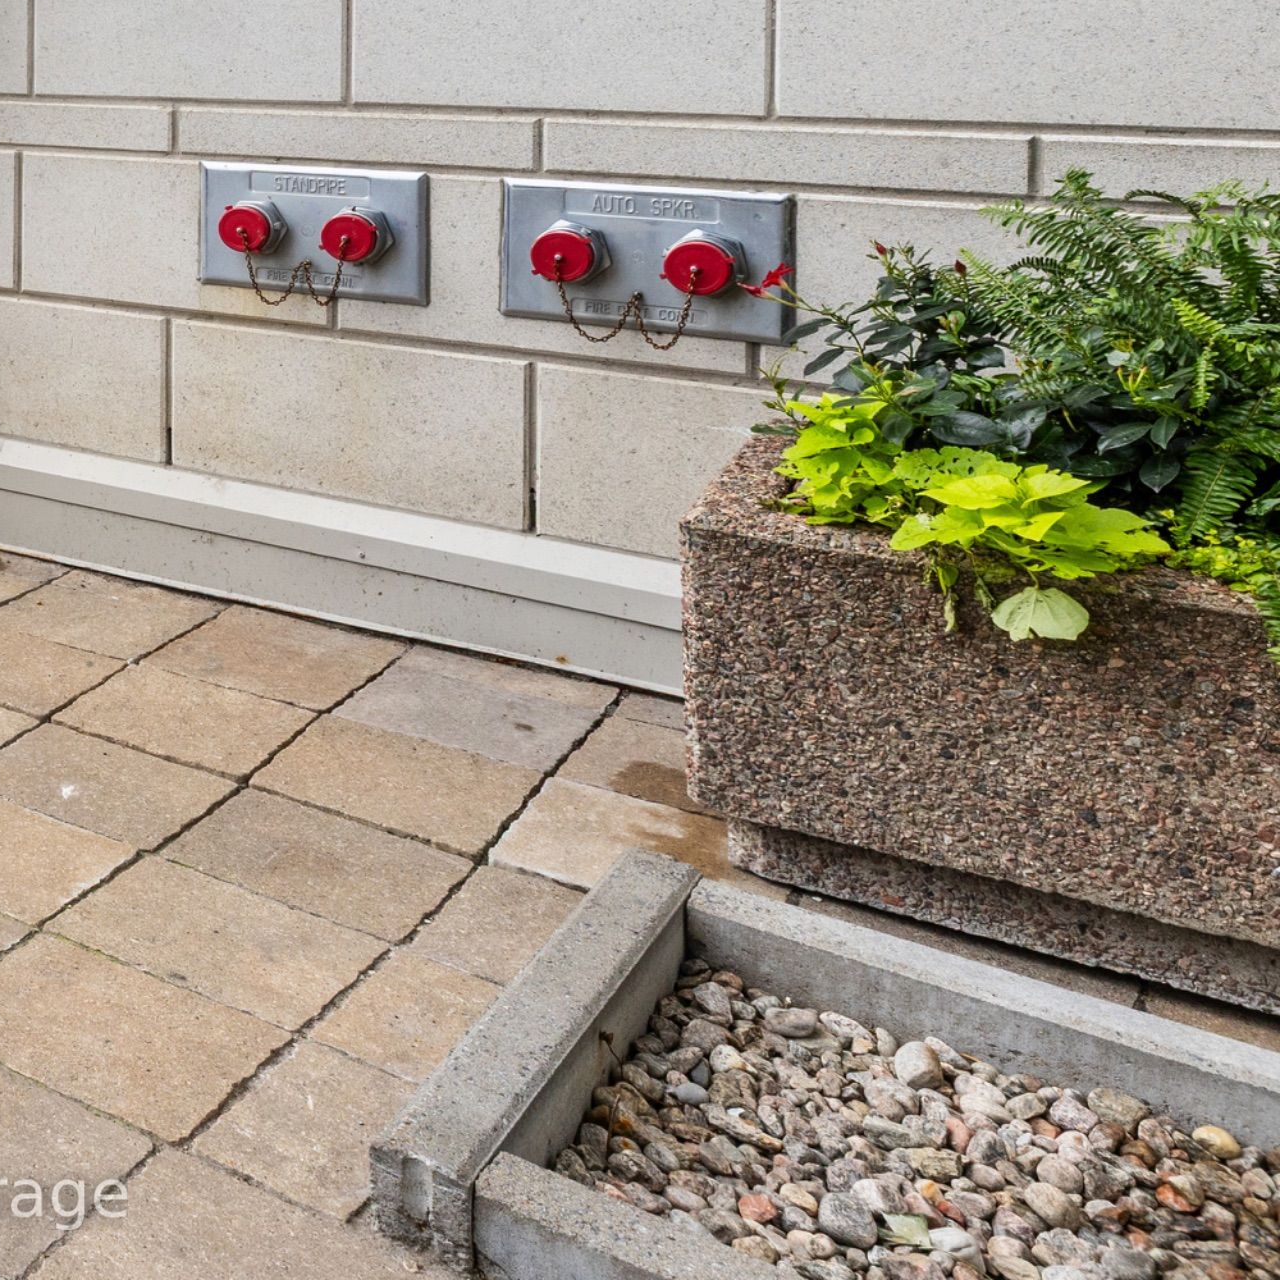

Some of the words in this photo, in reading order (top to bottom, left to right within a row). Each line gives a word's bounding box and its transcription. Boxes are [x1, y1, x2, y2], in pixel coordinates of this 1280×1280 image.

[273, 177, 347, 196] STANDPIPE
[266, 271, 288, 281] FIRE
[585, 301, 611, 313] FIRE
